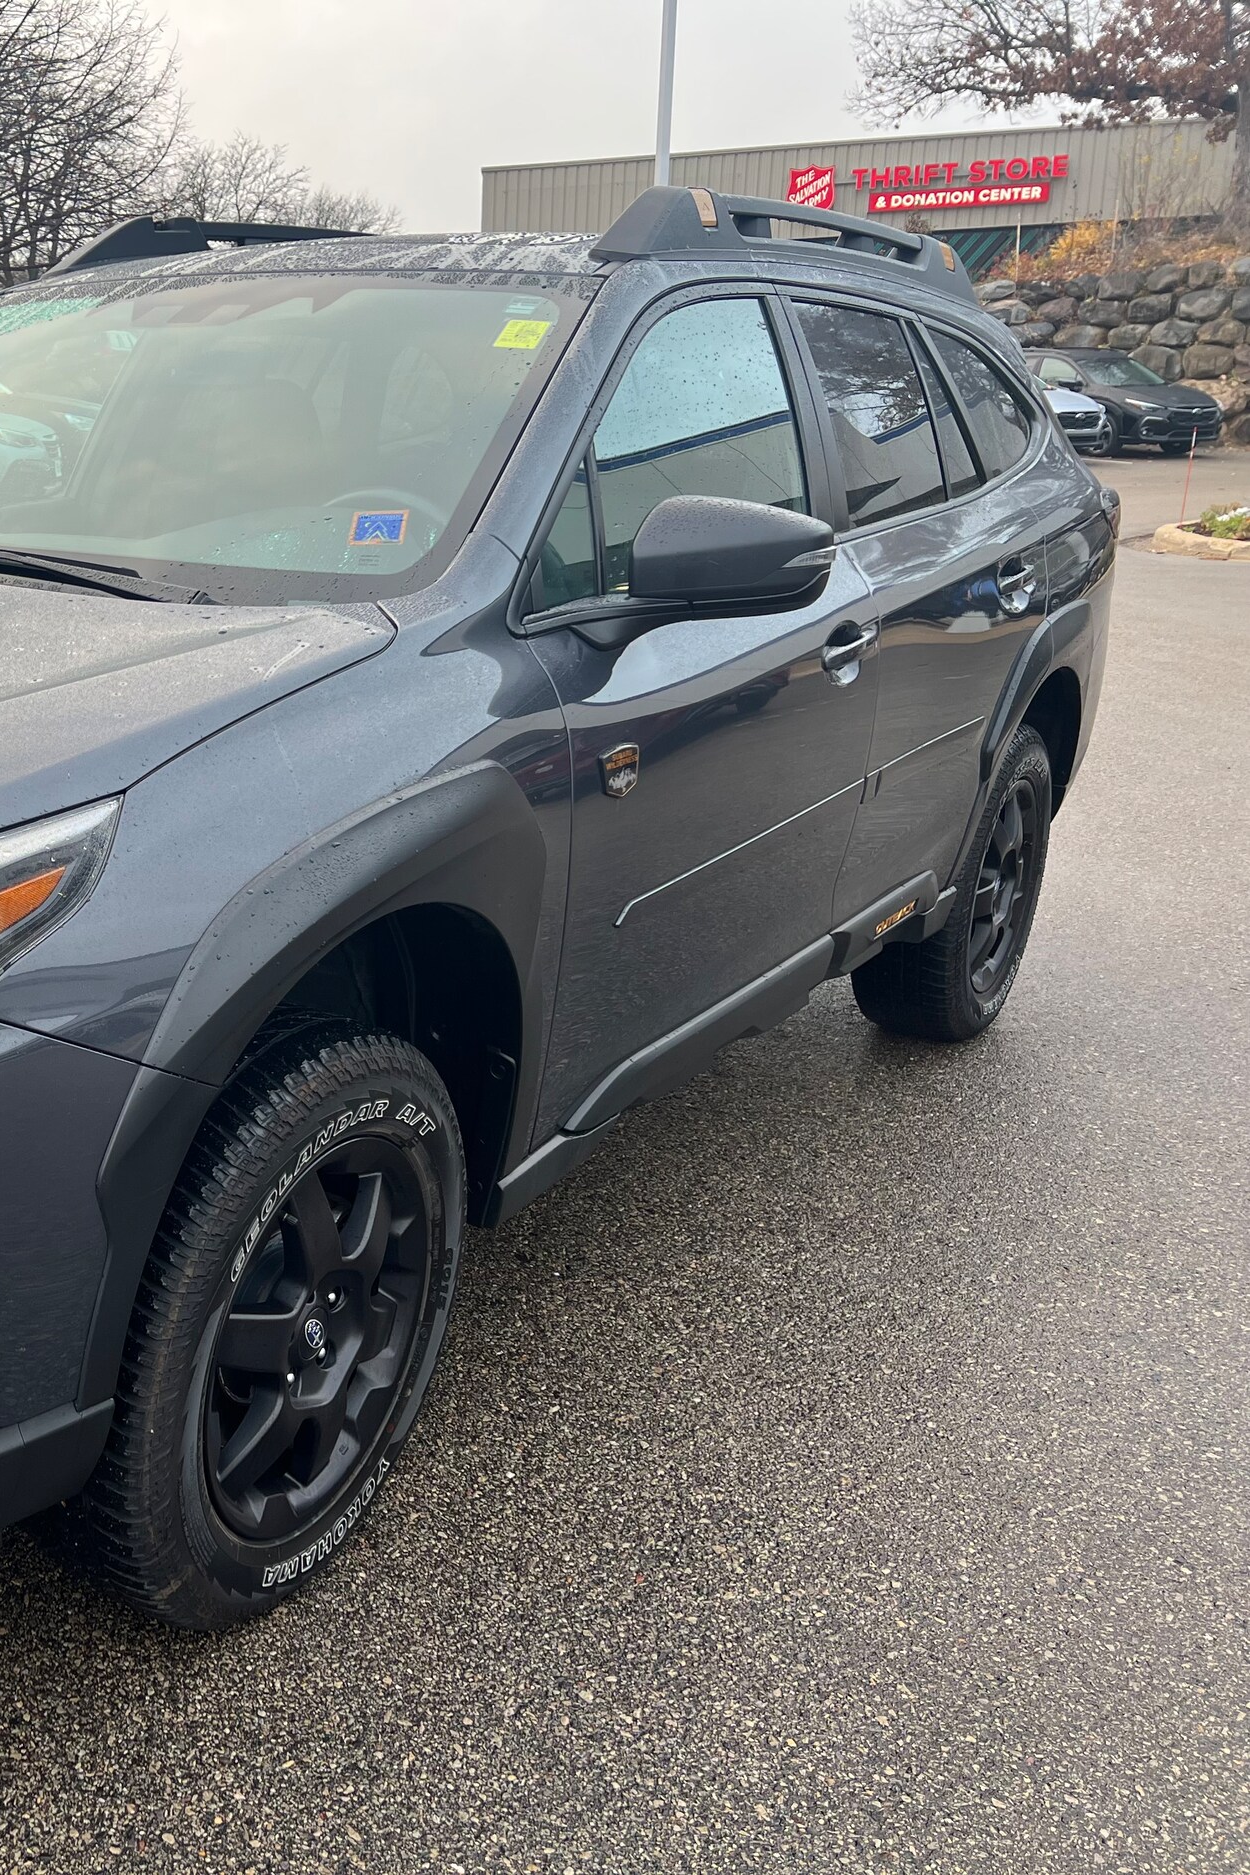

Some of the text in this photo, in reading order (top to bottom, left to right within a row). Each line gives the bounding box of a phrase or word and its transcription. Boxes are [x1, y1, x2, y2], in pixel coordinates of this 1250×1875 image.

[788, 170, 831, 203] SALVATION
[795, 169, 816, 189] THE
[852, 154, 1070, 190] THRIFT STORE
[875, 185, 1042, 209] & DONATION CENTER
[230, 1100, 390, 1283] GEOLANDAR
[395, 1103, 437, 1137] A/T
[261, 1458, 391, 1588] YOKOHAMA
